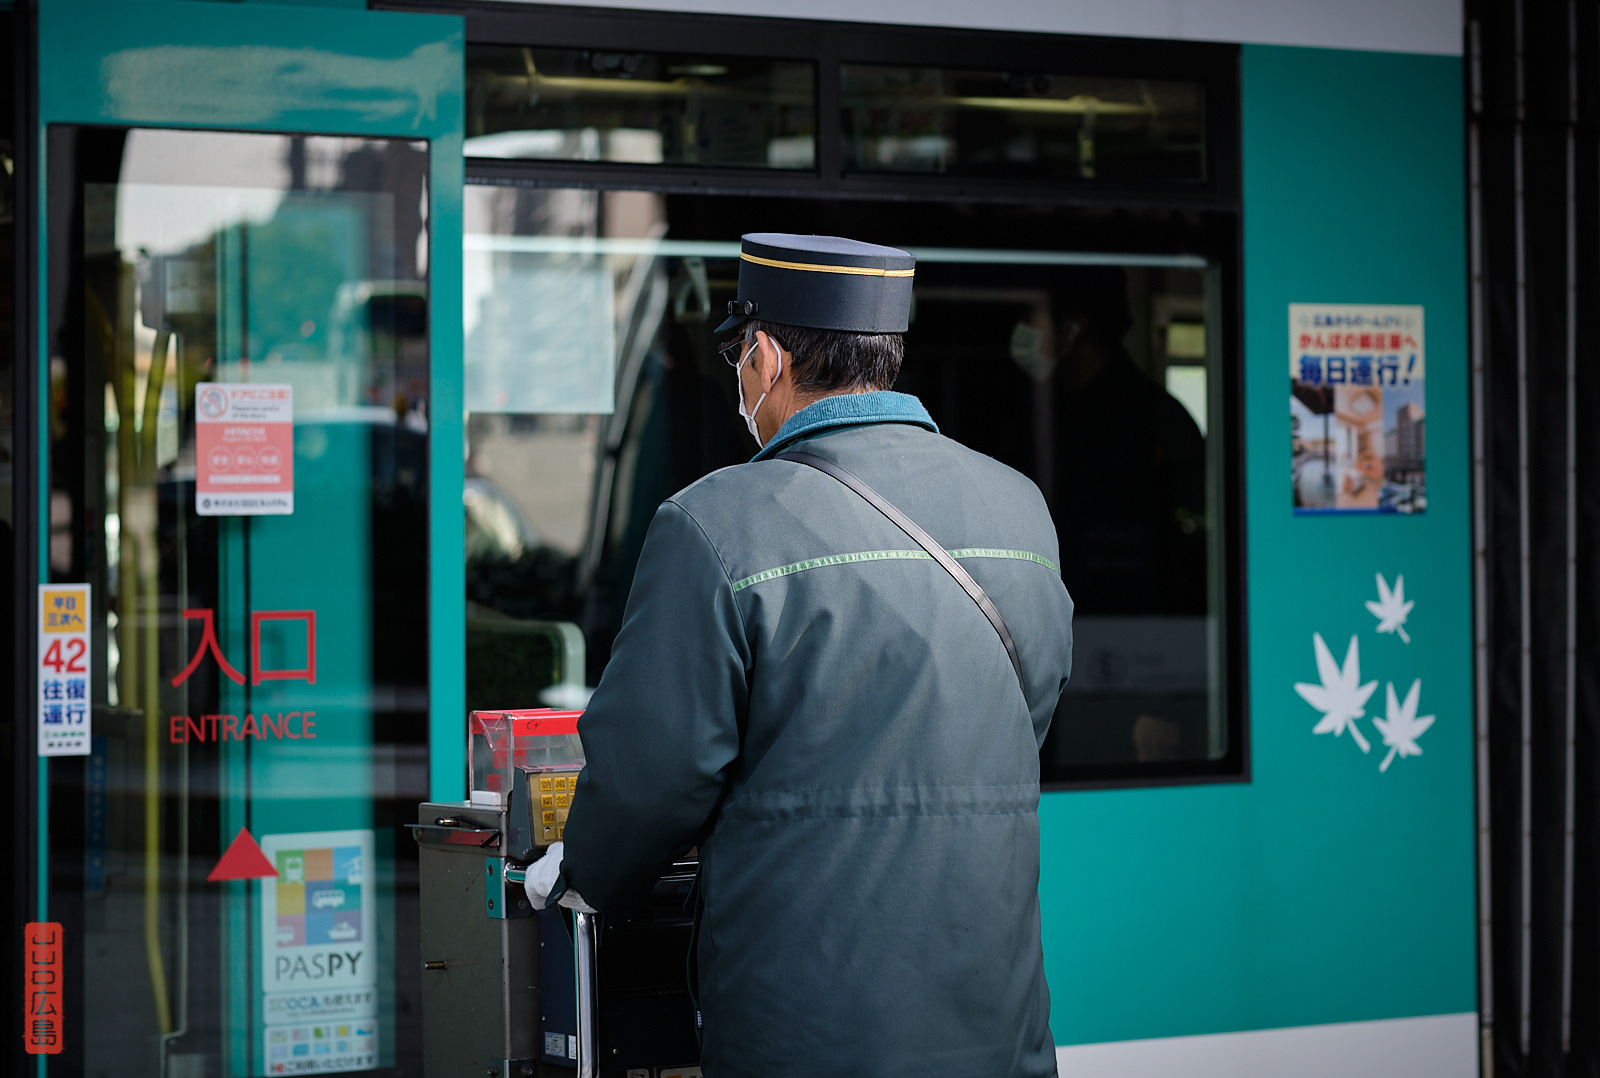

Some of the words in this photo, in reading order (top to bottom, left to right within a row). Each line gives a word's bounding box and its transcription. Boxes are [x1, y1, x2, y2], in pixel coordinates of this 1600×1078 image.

[53, 597, 76, 609] 平日
[43, 638, 87, 674] 42
[171, 608, 316, 688] 入口
[43, 678, 86, 700] 往復
[43, 703, 86, 725] 運行
[170, 711, 317, 744] ENTRANCE
[275, 951, 362, 982] PASPY
